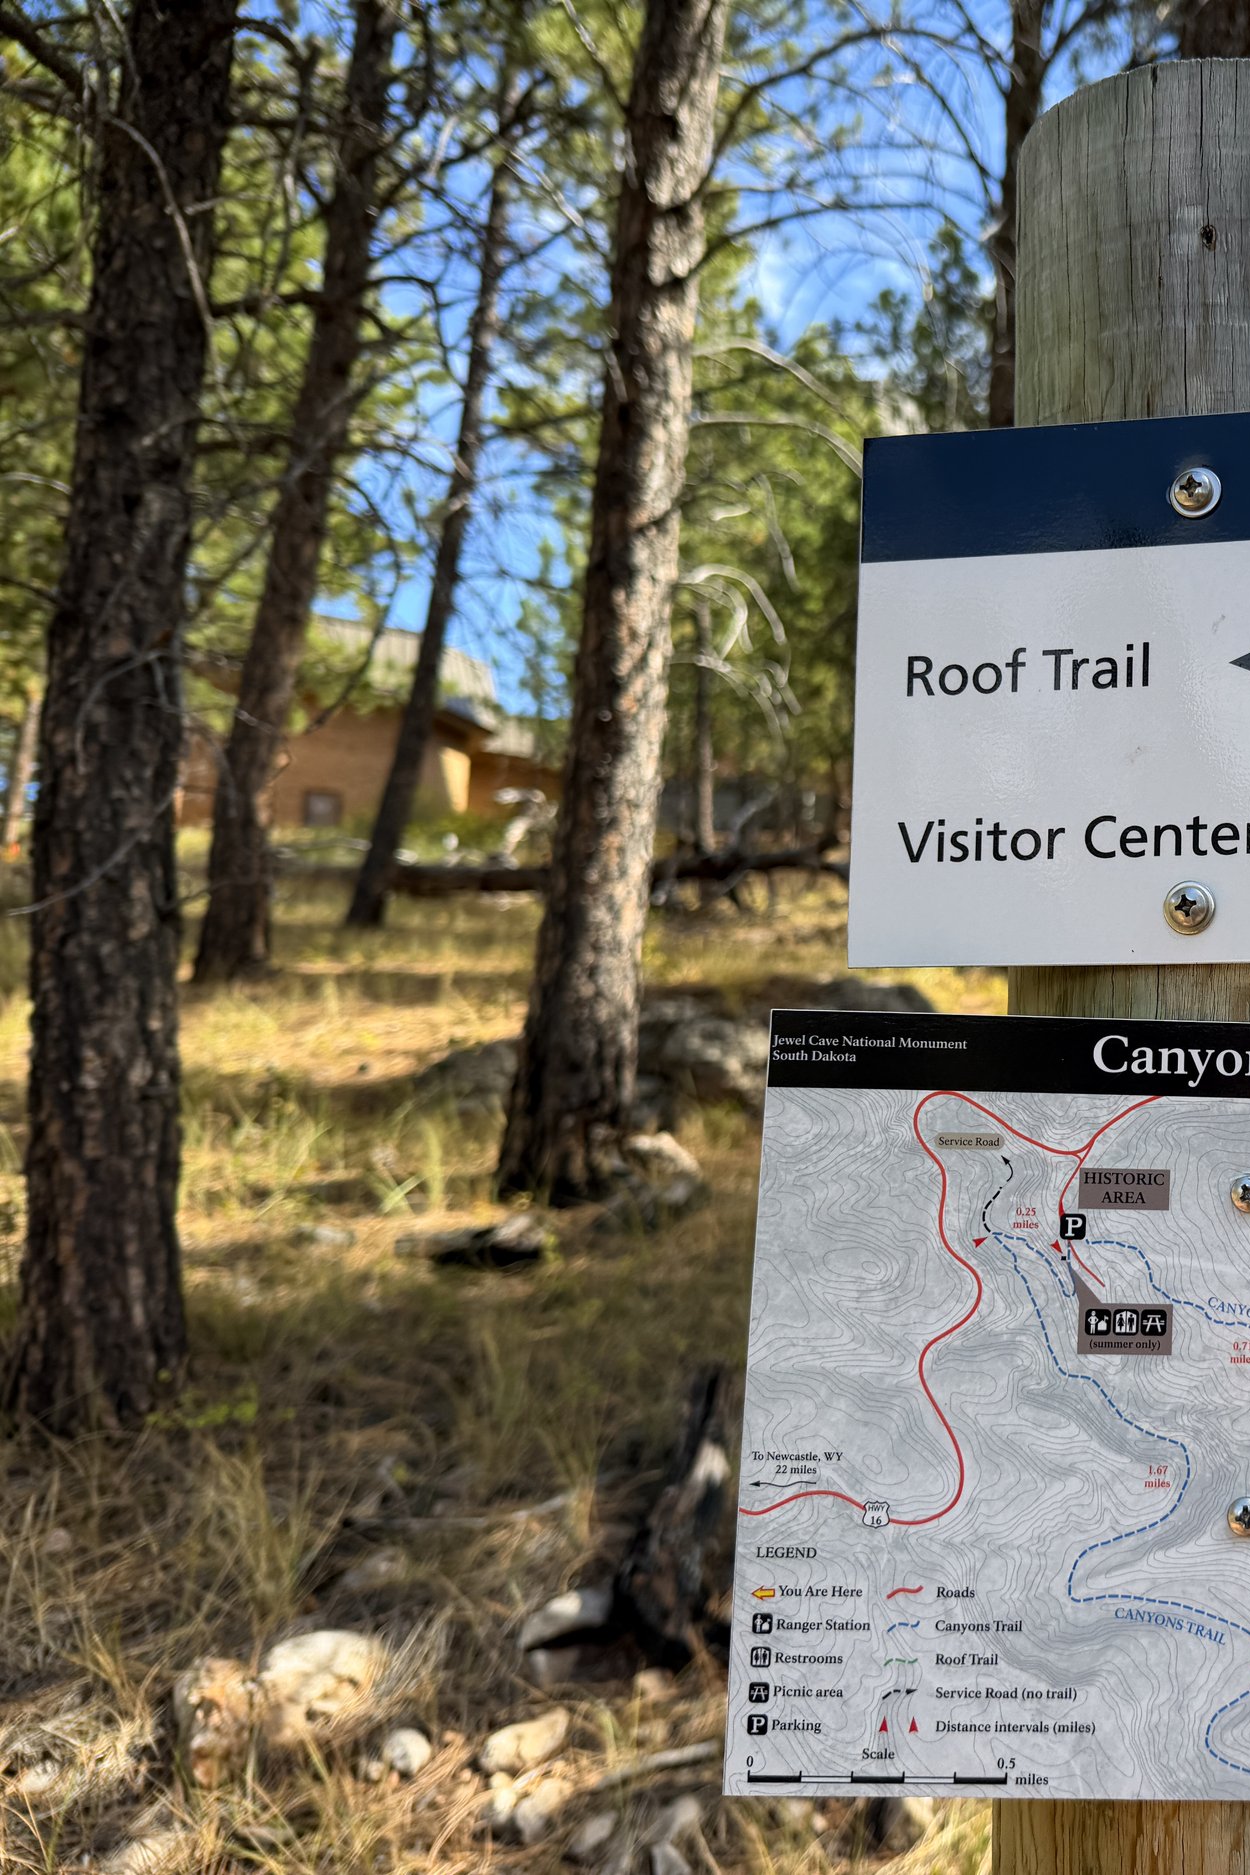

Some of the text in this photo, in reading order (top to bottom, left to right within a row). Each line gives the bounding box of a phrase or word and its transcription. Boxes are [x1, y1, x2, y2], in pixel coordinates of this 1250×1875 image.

[906, 642, 1151, 697] Roof Trail
[898, 818, 1065, 863] Visitor
[772, 1035, 967, 1050] Jewel Cave National Monument
[772, 1050, 856, 1063] South Dakota
[938, 1136, 1000, 1147] Service Road
[1083, 1171, 1165, 1187] HISTORIC
[1101, 1191, 1146, 1204] AREA
[1016, 1207, 1036, 1217] 0.25
[1013, 1219, 1039, 1230] miles
[1065, 1217, 1083, 1236] P
[1089, 1338, 1161, 1351] (summer only)
[752, 1451, 843, 1462] To Newcastle, WY
[776, 1465, 817, 1474] 22 miles
[1148, 1466, 1168, 1475] 1.67
[1144, 1478, 1171, 1489] miles
[871, 1516, 882, 1525] 16
[756, 1547, 817, 1558] LEGEND
[778, 1586, 863, 1597] You Are Here
[937, 1587, 975, 1598] Roads
[777, 1619, 870, 1633] Ranger Station
[935, 1620, 1023, 1635] Canyons Trail
[1114, 1607, 1226, 1645] CANYONS TRAIL
[775, 1652, 843, 1664] Restrooms
[935, 1653, 999, 1666] Roof Trail
[773, 1686, 843, 1697] Picnic area
[935, 1687, 1077, 1702] Service Road (no trail)
[751, 1717, 765, 1732] P
[771, 1720, 821, 1733] Parking
[935, 1721, 1096, 1736] Distance intervals (miles)
[862, 1749, 894, 1759] Scale
[746, 1756, 753, 1767] 0
[997, 1757, 1016, 1770] 0.5
[1015, 1773, 1049, 1786] miles
